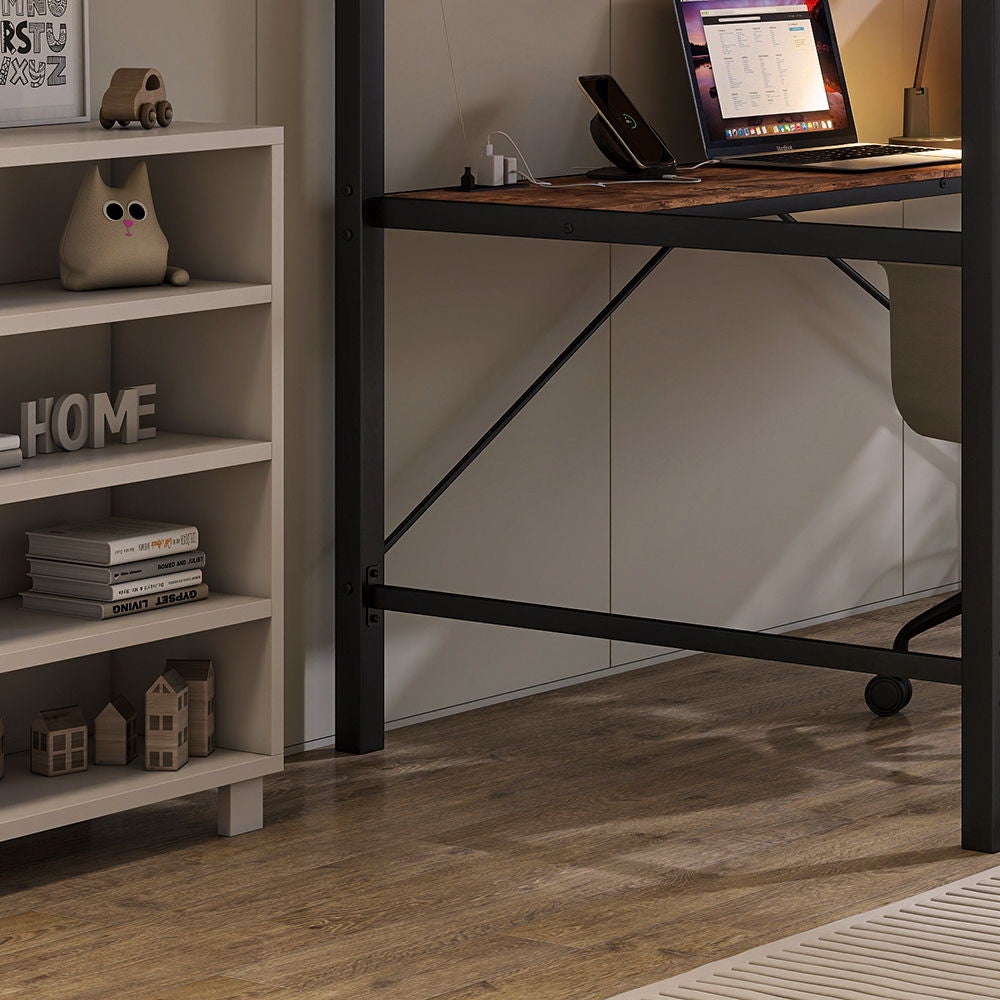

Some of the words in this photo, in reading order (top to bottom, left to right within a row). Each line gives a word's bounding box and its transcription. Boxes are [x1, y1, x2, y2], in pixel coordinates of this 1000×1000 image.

[20, 383, 157, 458] HOME
[157, 561, 176, 571] ROMEO
[176, 559, 187, 567] AND
[188, 556, 204, 565] JULIET
[155, 589, 197, 605] GYPSET
[112, 599, 148, 614] LIVING
